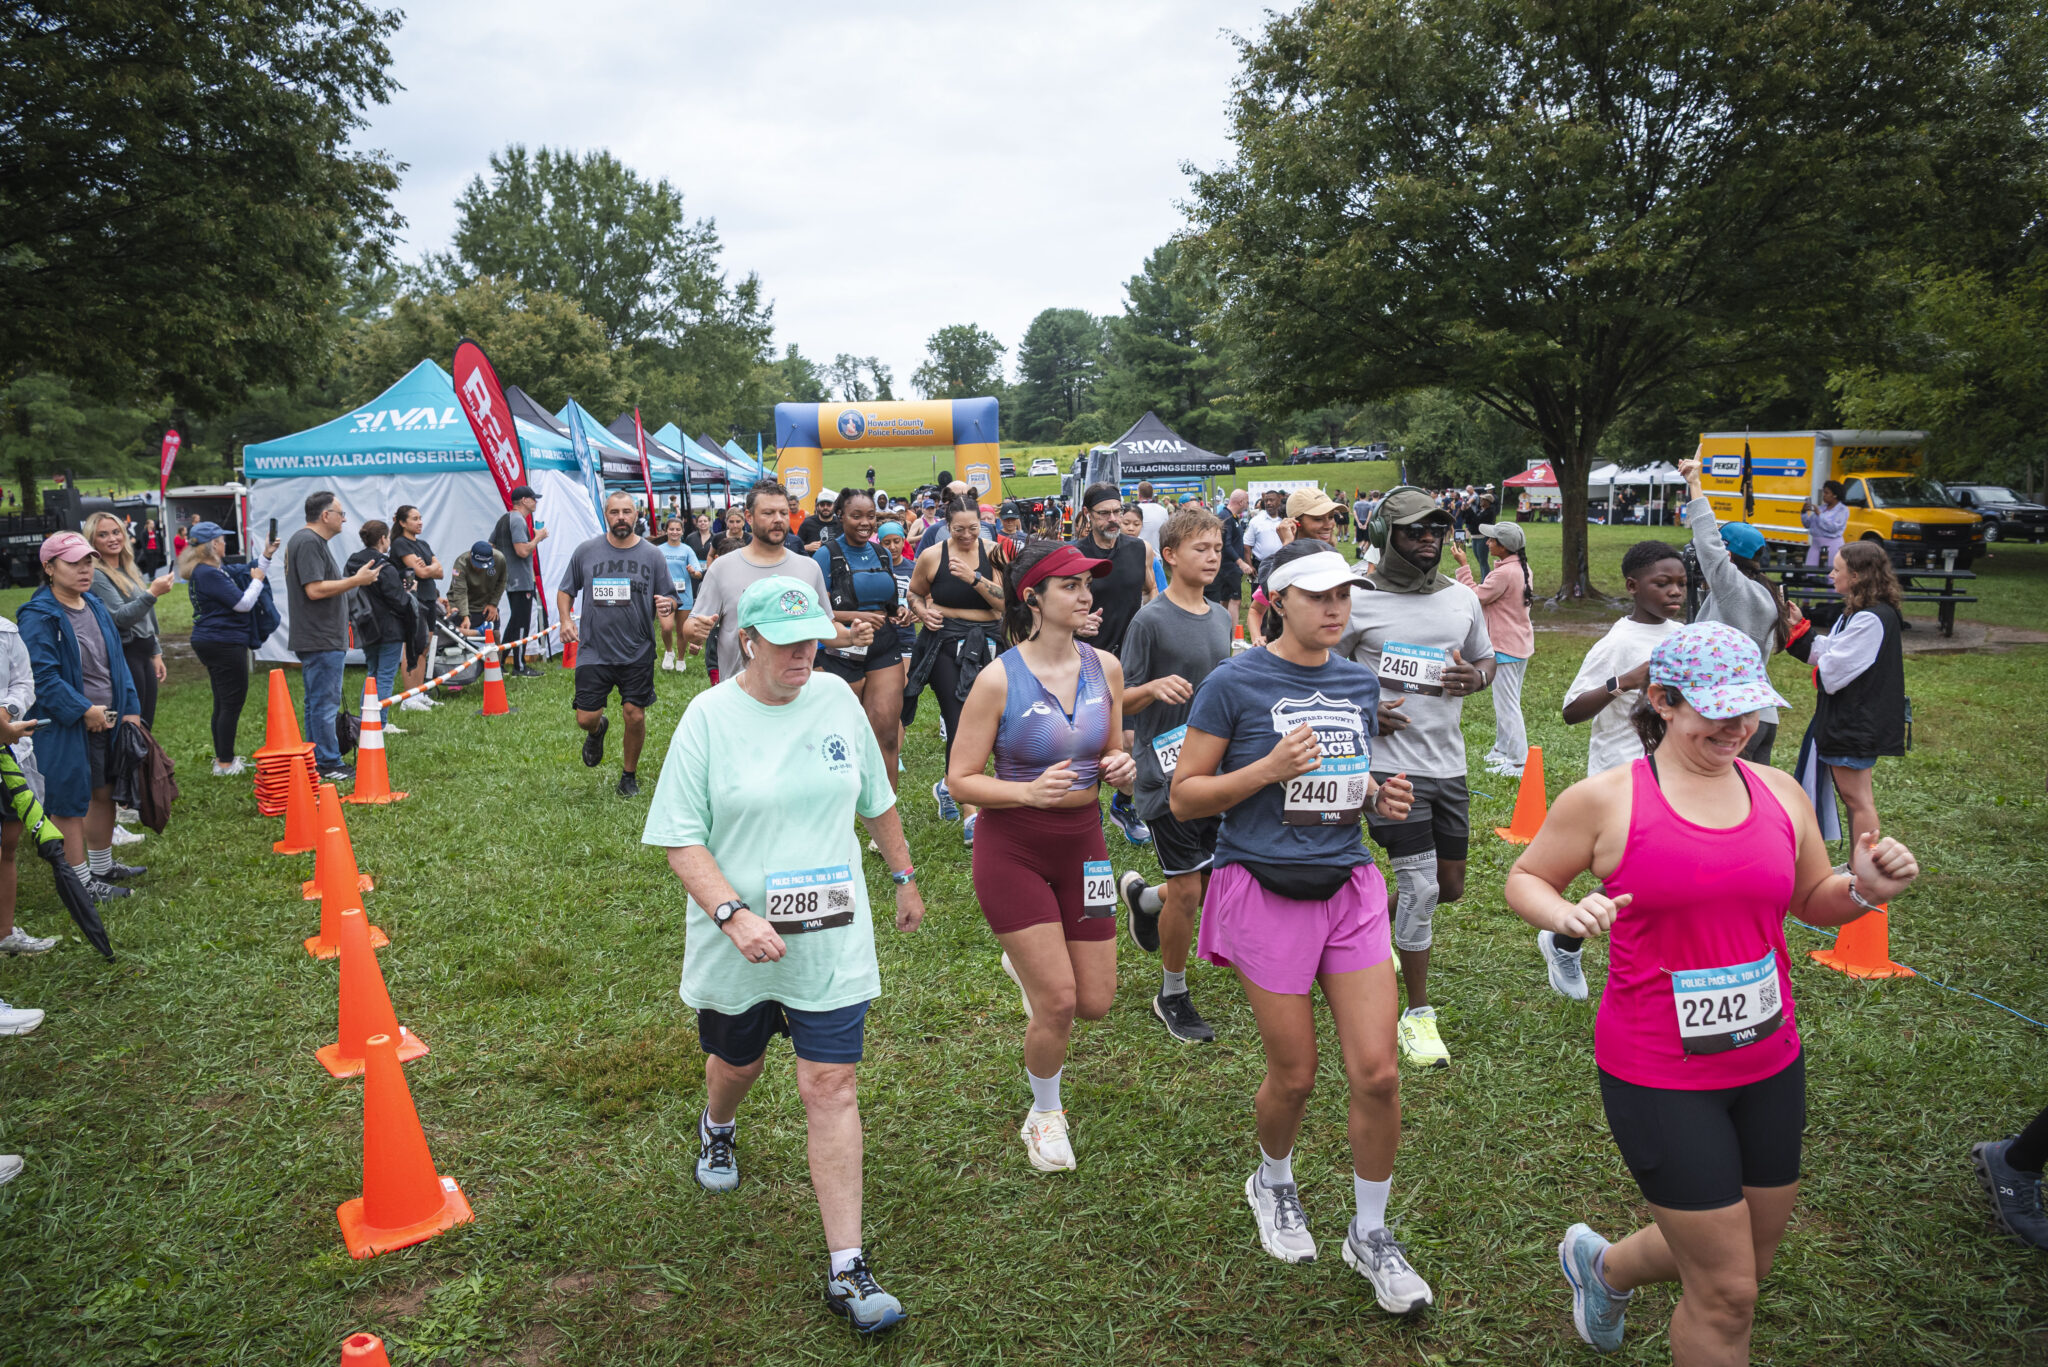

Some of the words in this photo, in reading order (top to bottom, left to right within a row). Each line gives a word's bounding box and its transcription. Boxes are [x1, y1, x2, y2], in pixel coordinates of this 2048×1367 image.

[352, 407, 459, 428] RIVAL
[867, 418, 896, 427] Howard
[898, 418, 924, 428] County
[350, 425, 388, 433] RACE
[398, 422, 447, 432] SERIES
[867, 428, 890, 436] Police
[892, 428, 934, 436] Foundation
[1122, 439, 1187, 451] RIVAL
[487, 437, 512, 494] PERFORM
[1122, 464, 1230, 474] VALRACINGSERIES.COM
[1713, 462, 1739, 470] PENSKE
[593, 560, 650, 580] UMBC
[594, 587, 613, 597] 2536
[1382, 656, 1419, 677] 2450
[1403, 682, 1419, 690] RIVAL
[1287, 714, 1323, 726] HOWARD
[1324, 715, 1355, 724] COUNTY
[1312, 730, 1354, 742] OLICE
[1318, 742, 1356, 756] ACE
[1290, 780, 1338, 804] 2440
[1320, 812, 1341, 820] RIVAL
[772, 877, 790, 886] POLICE
[792, 876, 805, 884] PACE
[1088, 879, 1112, 899] 240
[770, 891, 818, 915] 2288
[801, 919, 823, 929] RIVAL
[1680, 978, 1707, 988] POLICE
[1707, 975, 1726, 986] PACE
[1741, 972, 1755, 982] 10K
[1682, 993, 1748, 1027] 2242
[1730, 1027, 1757, 1041] RIVAL
